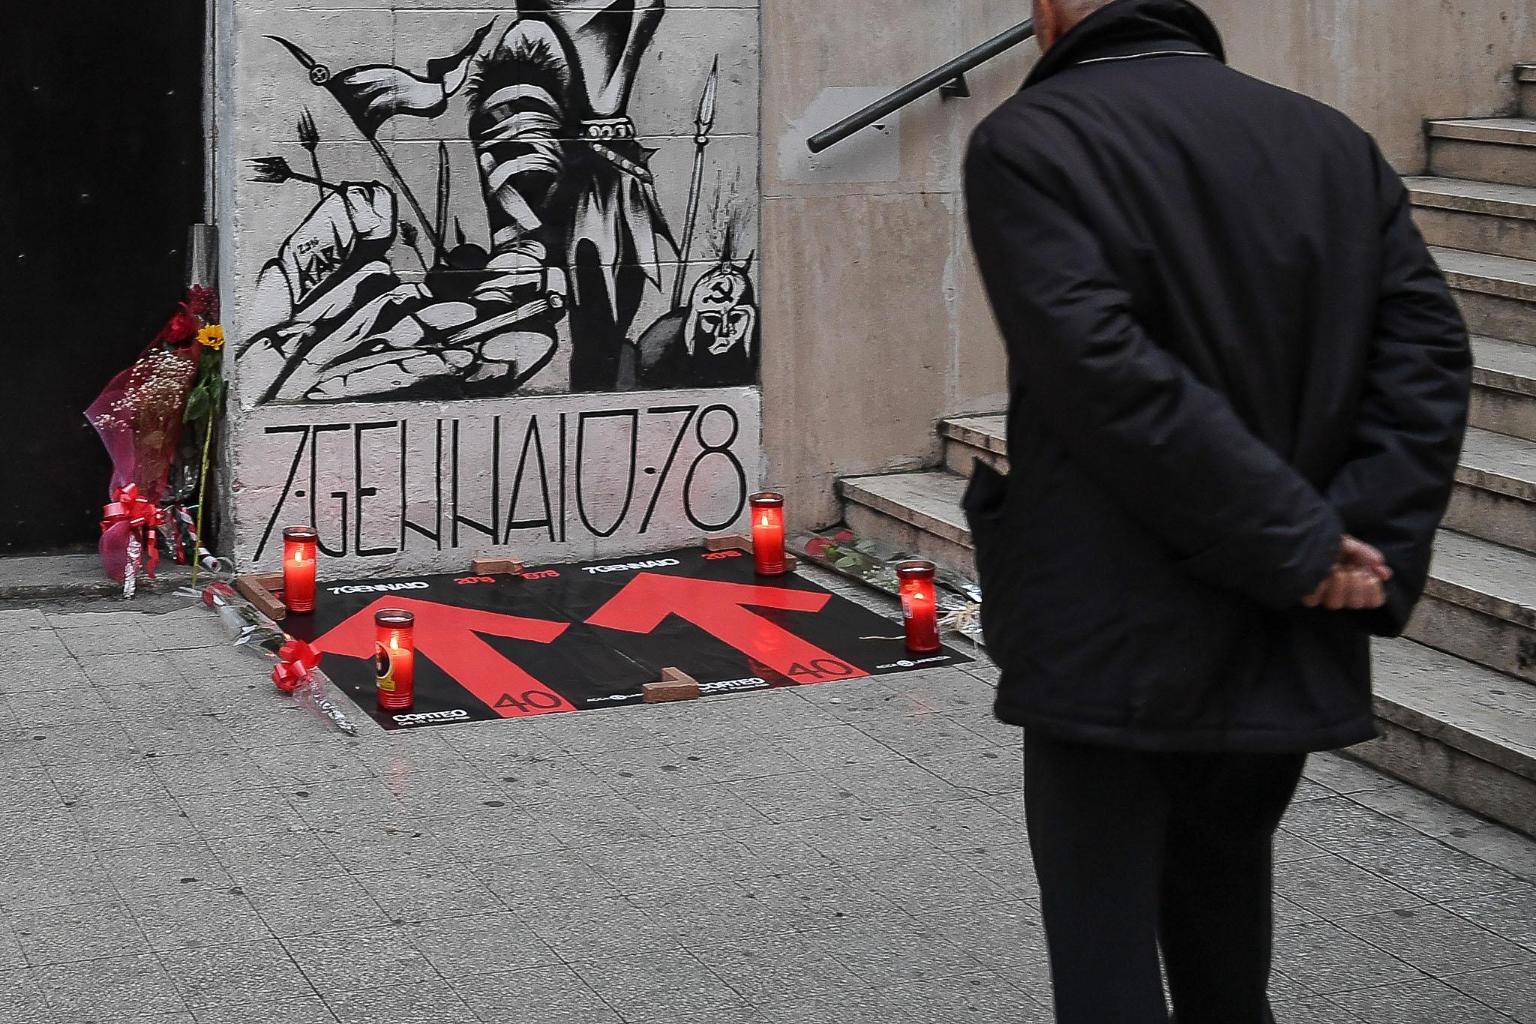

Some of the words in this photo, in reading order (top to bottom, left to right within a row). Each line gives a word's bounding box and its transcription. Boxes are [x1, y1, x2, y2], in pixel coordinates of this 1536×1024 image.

[787, 658, 854, 679] 40
[492, 689, 562, 713] 40
[392, 709, 468, 722] CORTEO
